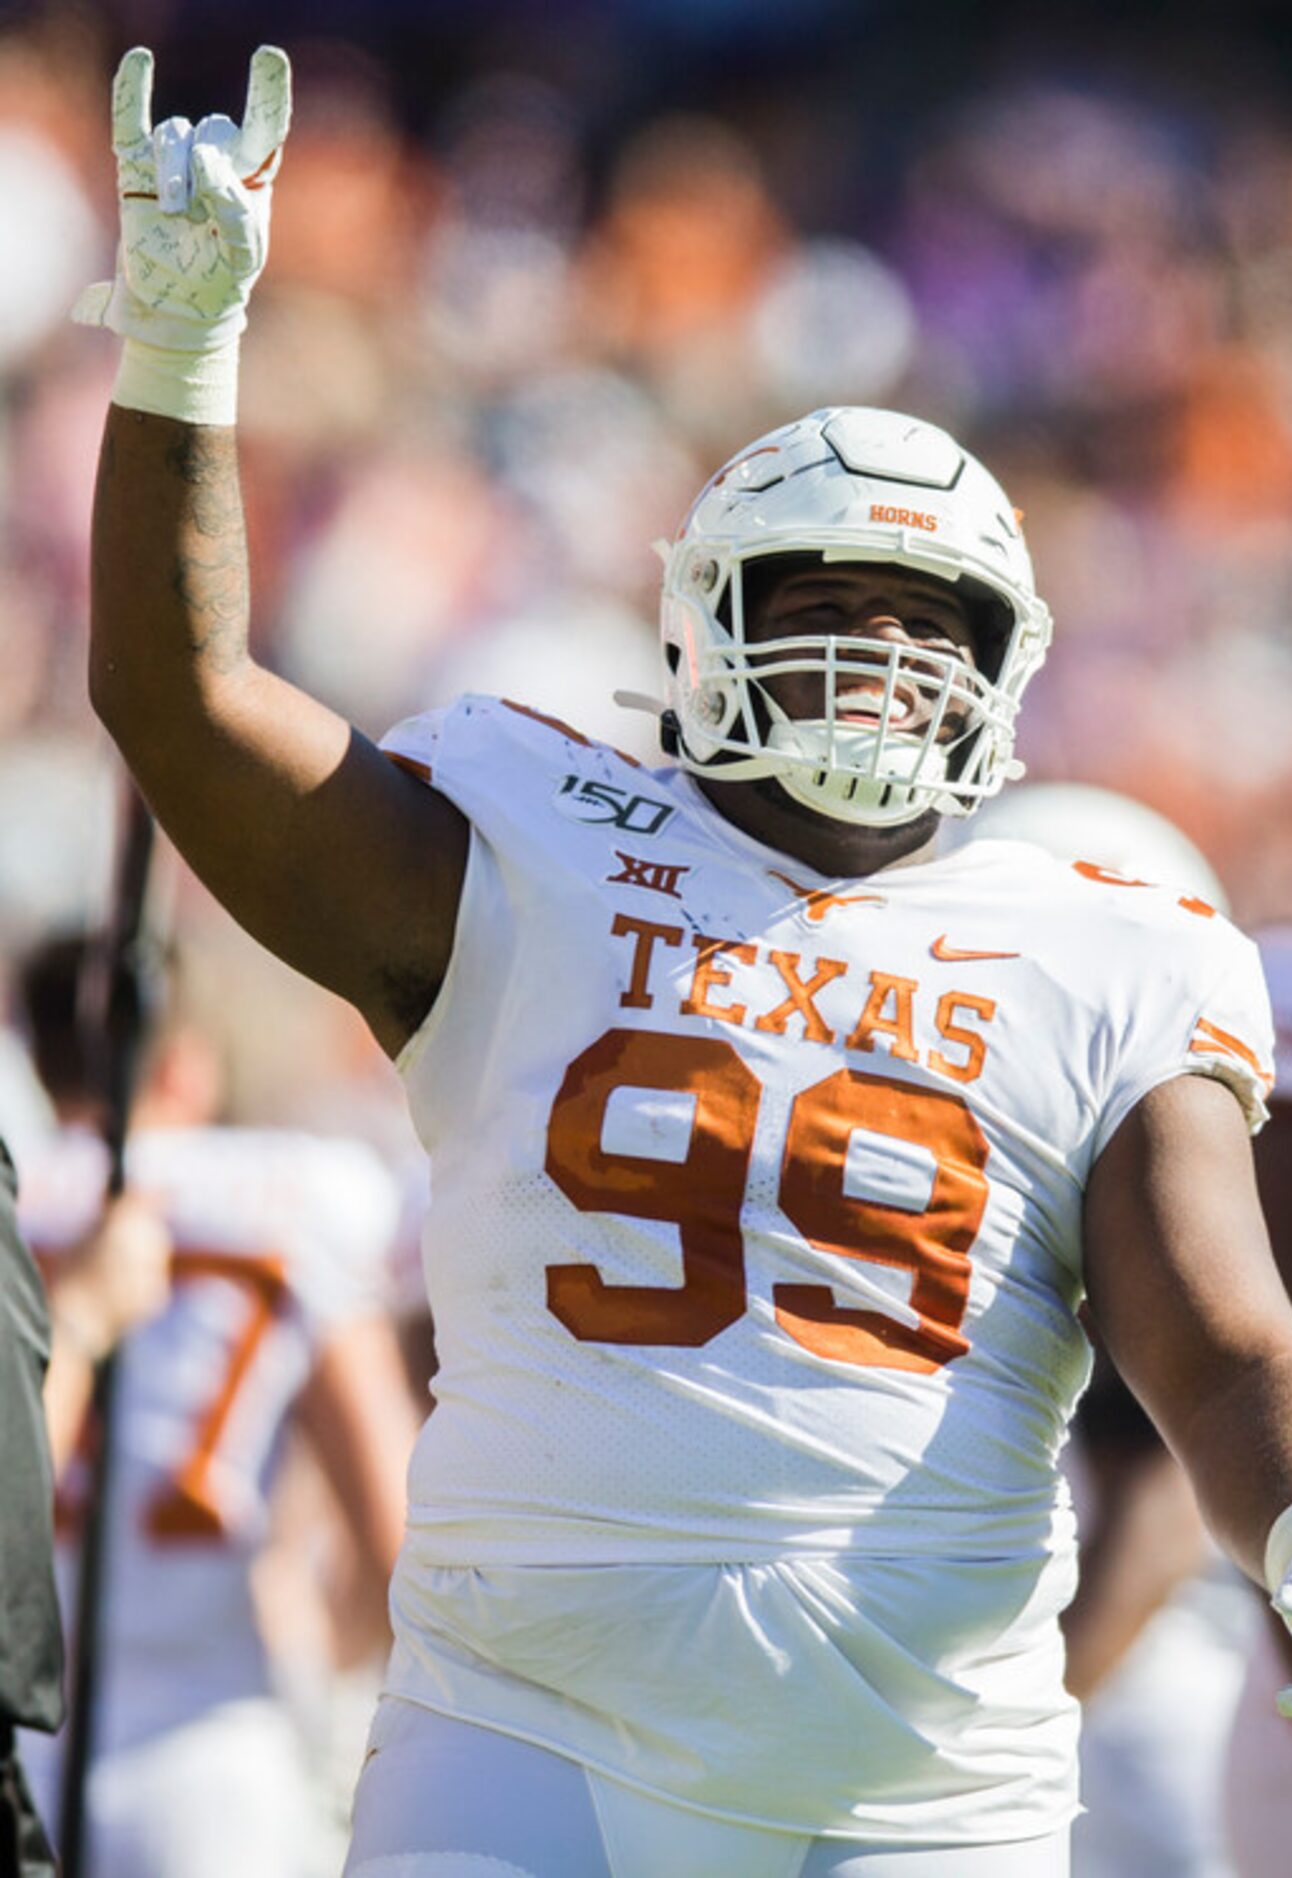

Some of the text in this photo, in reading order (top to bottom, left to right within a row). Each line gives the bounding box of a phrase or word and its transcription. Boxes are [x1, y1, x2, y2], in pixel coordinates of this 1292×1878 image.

[869, 504, 938, 532] HORNS
[560, 775, 675, 835] 150
[606, 850, 692, 899] XII
[609, 912, 997, 1084] TEXAS
[544, 1028, 990, 1376] 99
